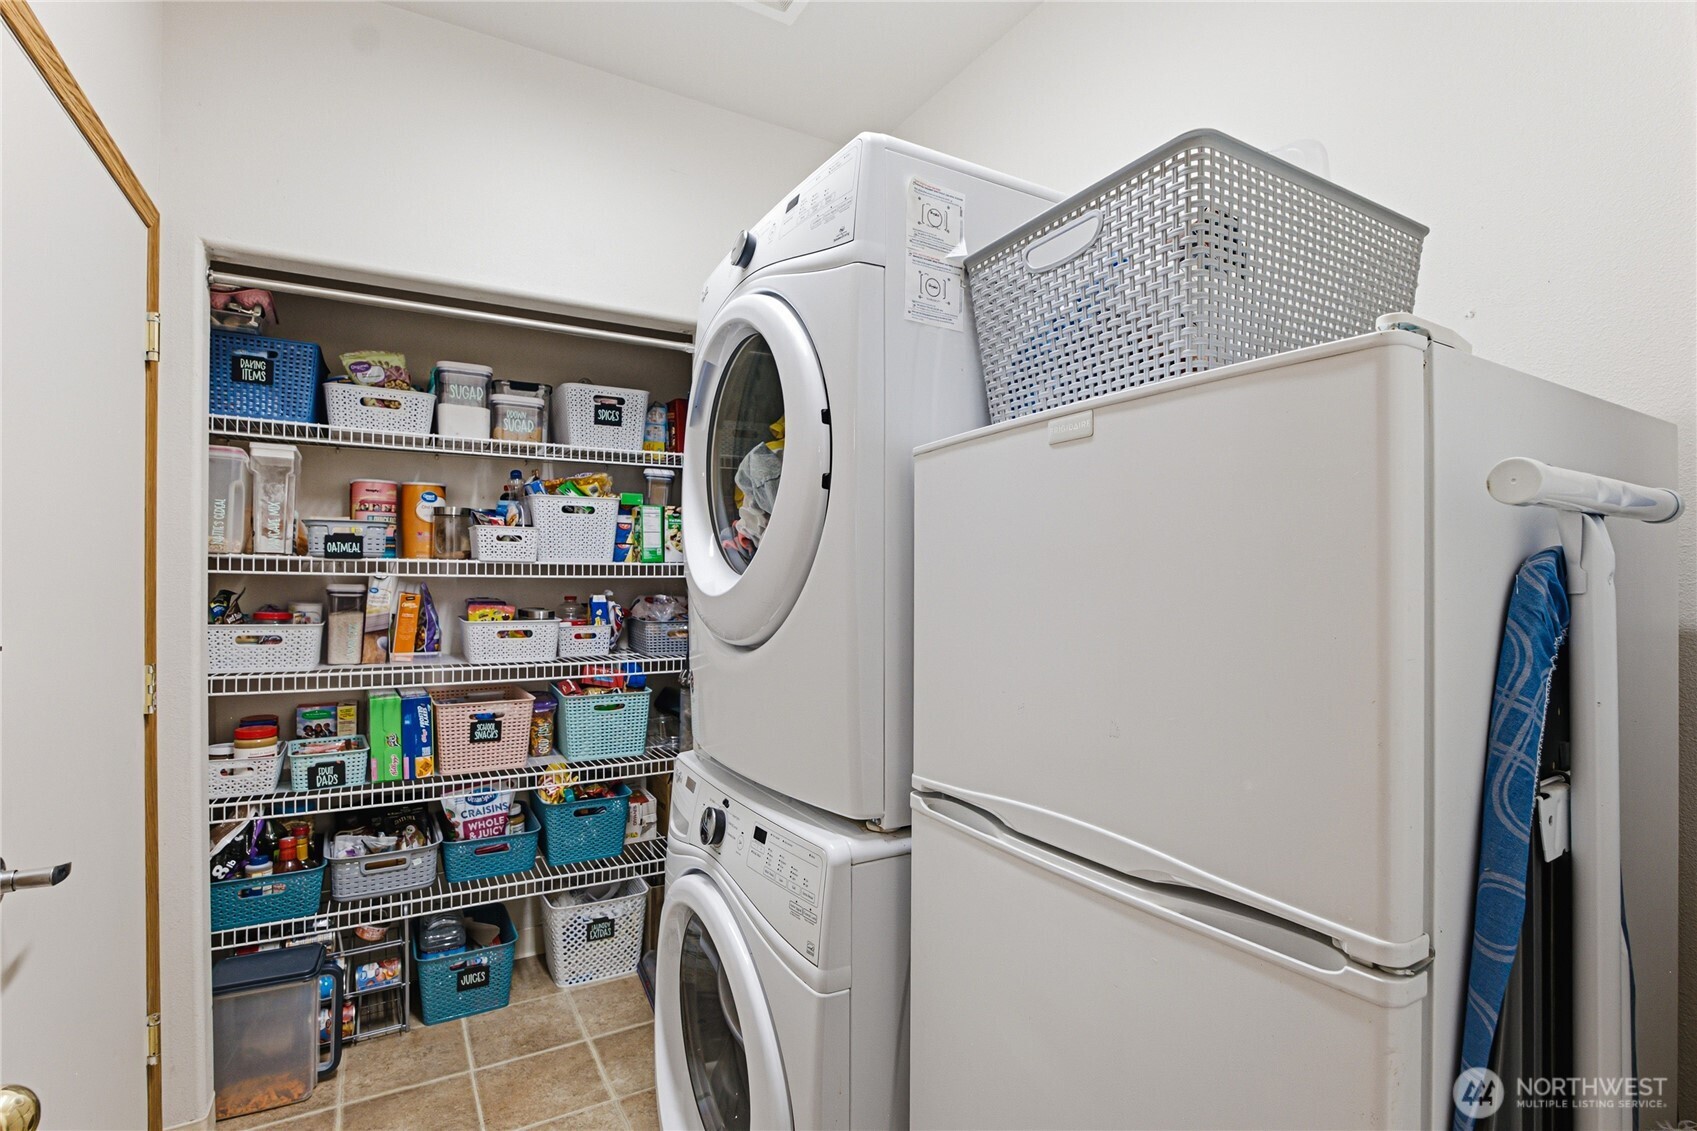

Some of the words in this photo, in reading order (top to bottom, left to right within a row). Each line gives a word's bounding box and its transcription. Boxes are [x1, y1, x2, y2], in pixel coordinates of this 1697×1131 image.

[241, 368, 267, 382] ITEMS
[597, 409, 620, 422] SPICES
[267, 501, 281, 516] MIX
[326, 541, 362, 553] OATMEAL
[474, 729, 499, 740] SNACKS
[476, 722, 495, 732] SCHOOL
[461, 801, 509, 819] CRAISINS
[467, 816, 505, 831] WHOLE
[469, 832, 477, 840] &
[478, 825, 505, 839] JUICY
[212, 864, 230, 880] 8
[226, 859, 237, 869] lb
[460, 971, 486, 986] JUICES
